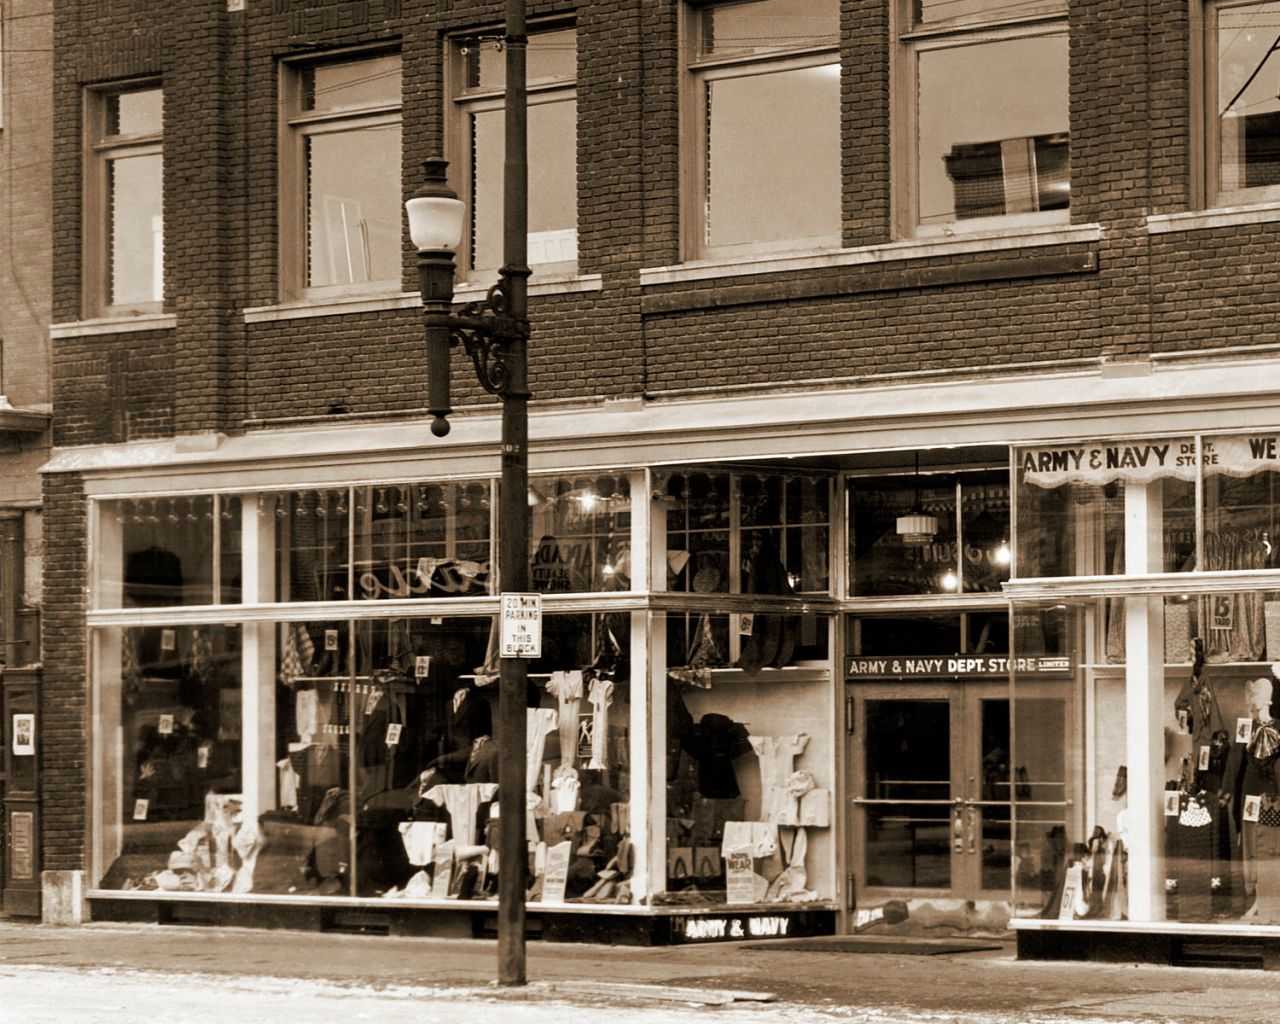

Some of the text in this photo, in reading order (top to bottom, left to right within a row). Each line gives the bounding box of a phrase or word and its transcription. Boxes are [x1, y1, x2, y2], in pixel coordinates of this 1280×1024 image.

[1023, 444, 1171, 473] ARMY & NAVY
[1248, 437, 1277, 460] WE
[512, 634, 533, 643] THIS
[849, 660, 888, 674] ARMY
[892, 659, 902, 673] &
[905, 659, 943, 673] NAVY
[947, 658, 986, 673] DEPT.
[729, 919, 745, 937] &
[748, 916, 789, 936] NAVY
